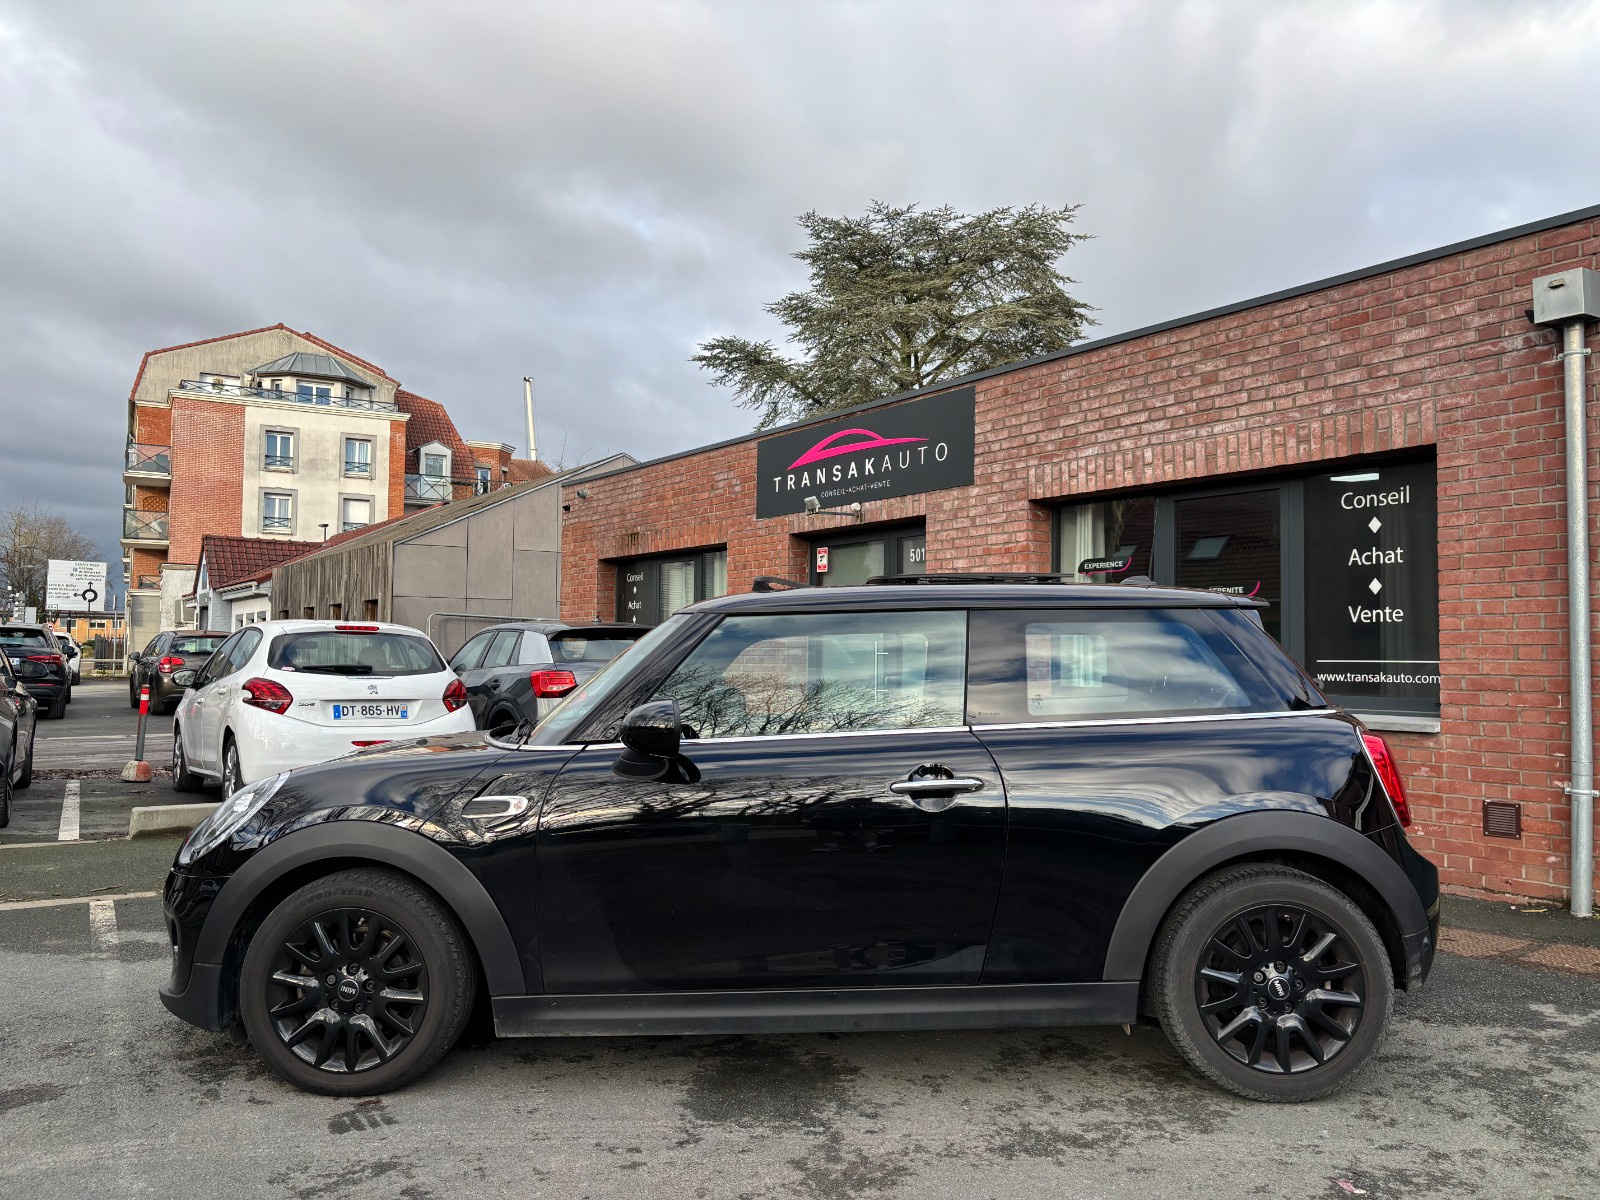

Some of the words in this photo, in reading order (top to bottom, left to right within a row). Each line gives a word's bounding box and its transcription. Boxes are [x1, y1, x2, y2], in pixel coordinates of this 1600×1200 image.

[773, 442, 948, 493] TRANSAKAUTO
[820, 479, 891, 498] CONSEIL-ACHAT-VENTE
[1340, 485, 1410, 510] Conseil
[909, 547, 925, 562] 501
[1348, 546, 1404, 566] Achat
[1084, 560, 1124, 570] EXPERIENCE
[626, 571, 644, 582] Conseil
[627, 600, 642, 610] Achat
[1348, 606, 1404, 623] Vente
[1317, 671, 1441, 684] www.transakauto.com
[341, 705, 400, 717] DT-865-HV
[341, 986, 356, 995] MINI
[1274, 980, 1285, 996] MINI
